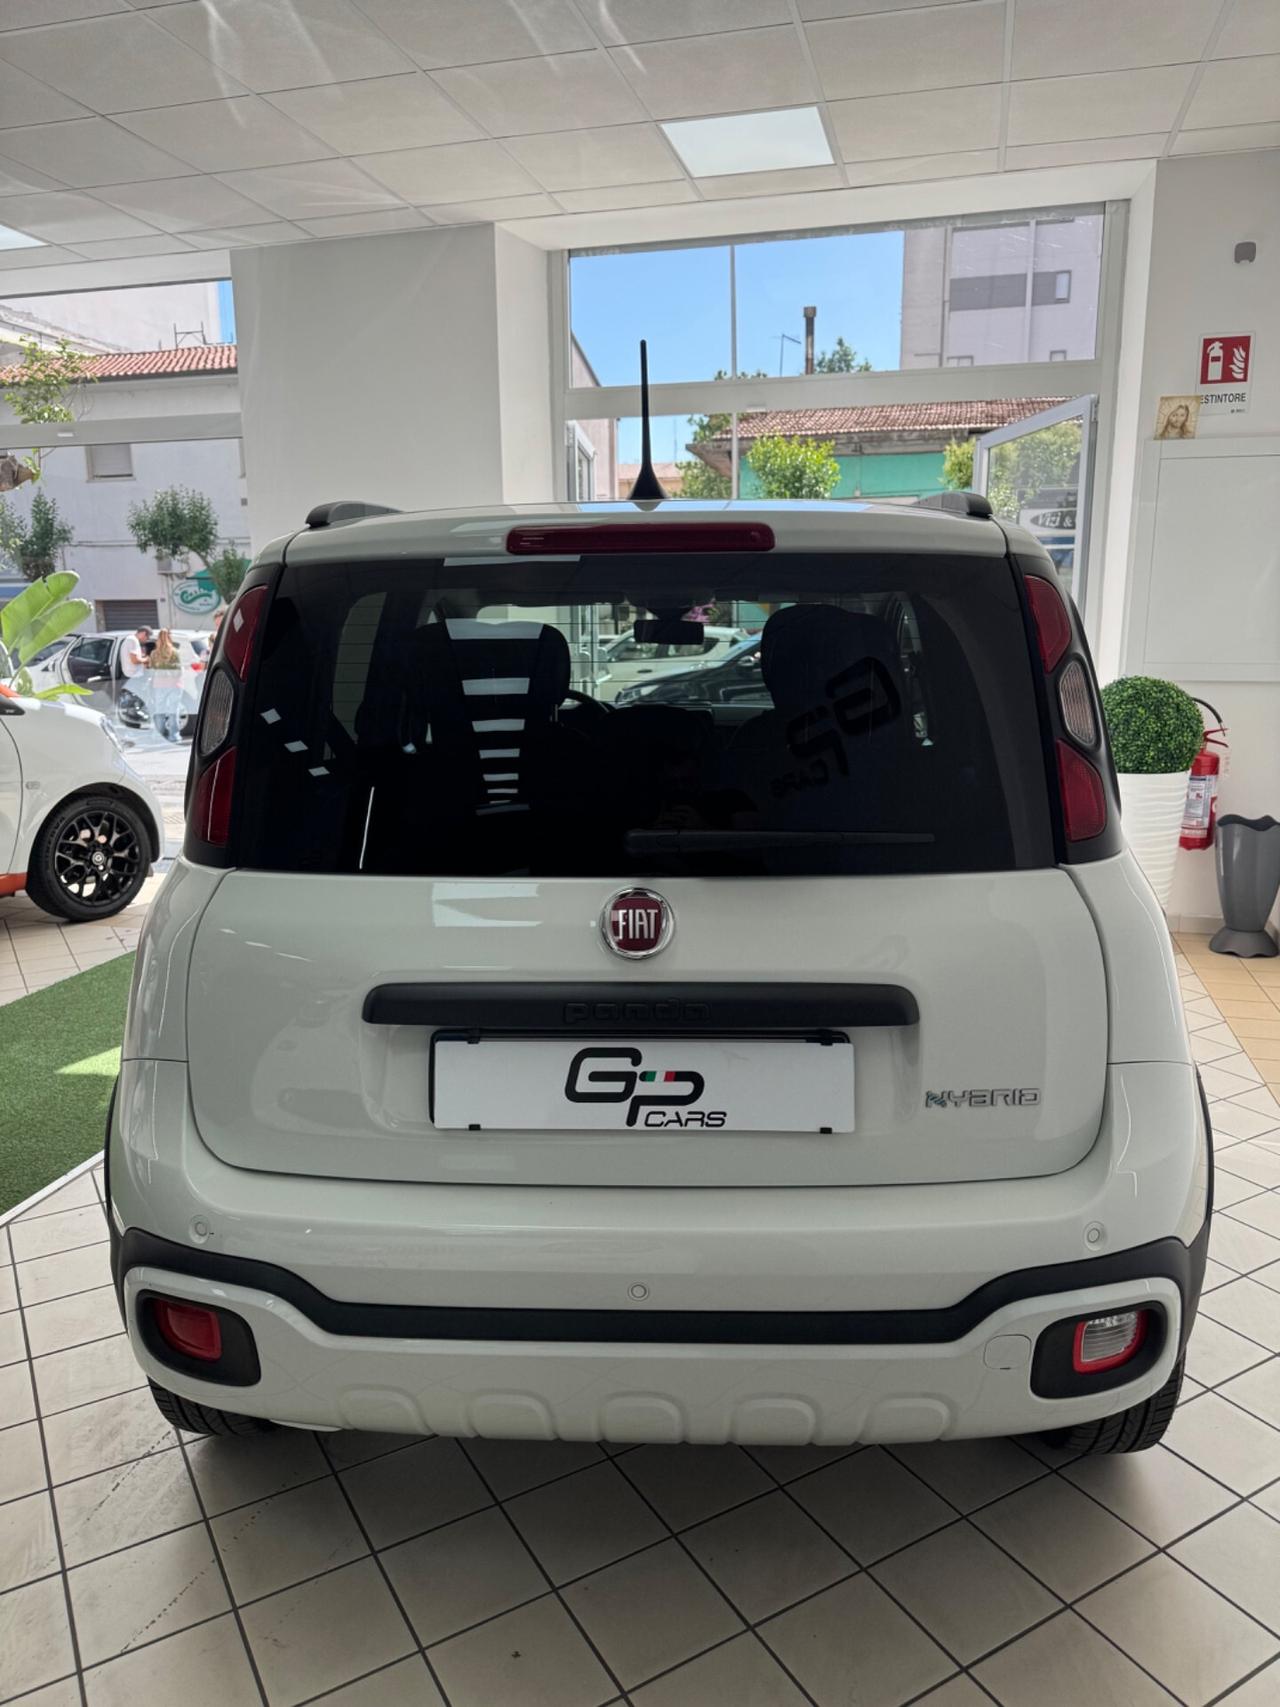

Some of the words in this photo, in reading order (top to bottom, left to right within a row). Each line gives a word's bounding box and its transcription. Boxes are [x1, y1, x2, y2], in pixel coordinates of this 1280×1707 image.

[1200, 392, 1246, 404] ESTINTORE
[617, 908, 658, 940] FIAT
[564, 1047, 705, 1127] GP
[644, 1111, 727, 1128] CARS
